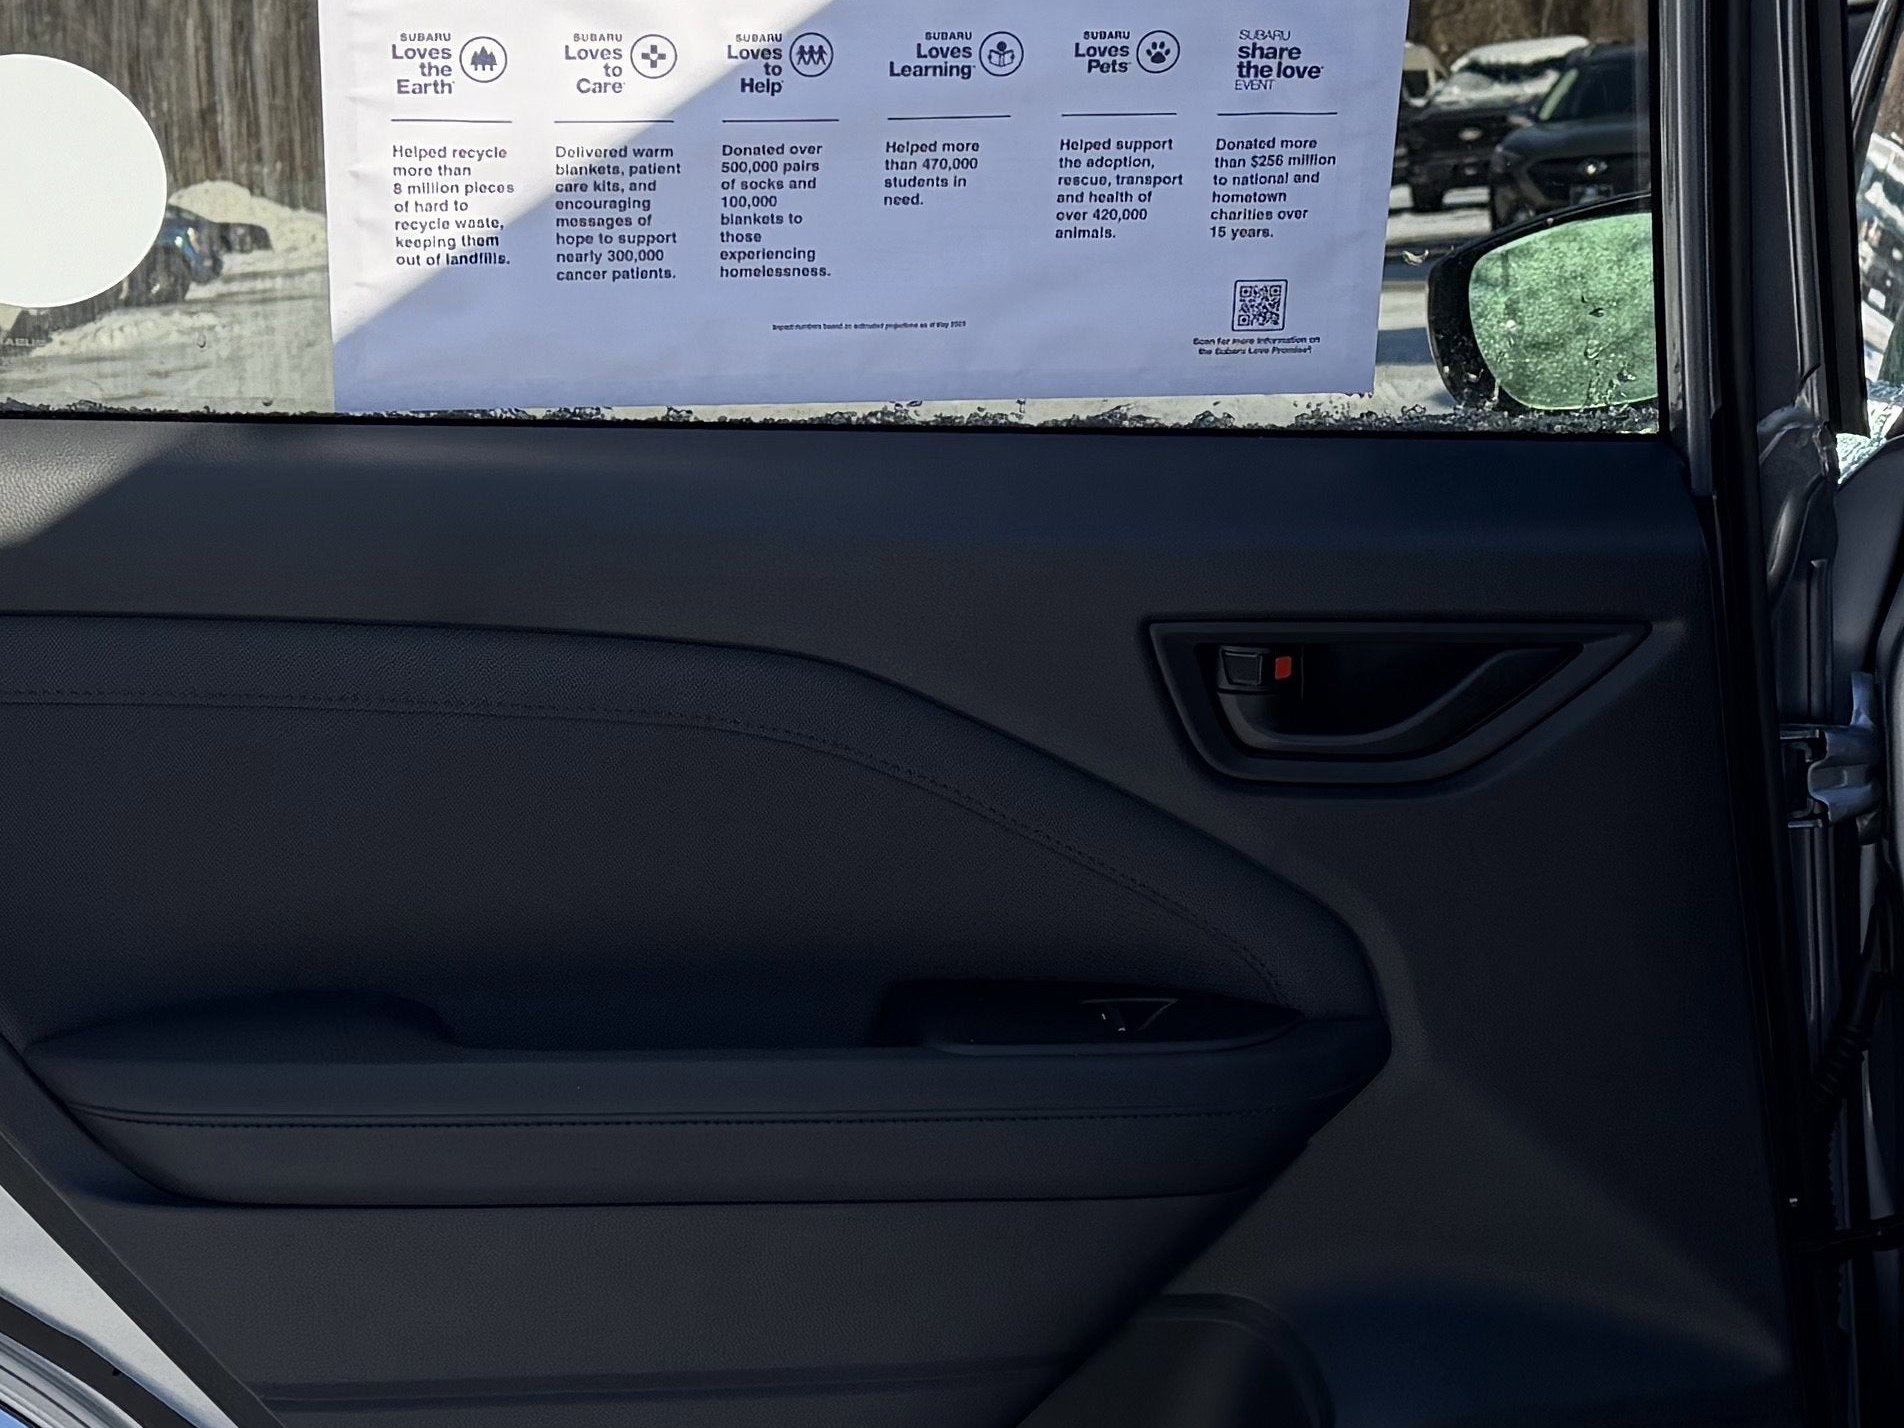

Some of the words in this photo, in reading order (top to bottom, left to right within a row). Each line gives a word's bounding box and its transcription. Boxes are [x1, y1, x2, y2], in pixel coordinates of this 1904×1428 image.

[400, 33, 451, 41] SUBARU
[574, 33, 622, 42] SUBARU
[736, 33, 782, 42] SUBARU
[925, 32, 972, 40] SUBARU
[1084, 31, 1130, 40] SUBARU
[1239, 30, 1290, 41] SUBARU
[392, 44, 452, 59] Loves
[565, 45, 622, 60] Loves
[728, 45, 782, 60] Loves
[917, 43, 972, 58] Loves
[1075, 43, 1129, 57] Loves
[1238, 42, 1301, 61] share
[419, 62, 452, 76] the
[603, 63, 622, 77] to
[764, 62, 782, 76] to
[890, 61, 971, 80] Learning
[1088, 59, 1128, 73] Pets
[1237, 60, 1273, 78] the
[1276, 61, 1321, 79] love
[397, 79, 455, 94] Earth
[576, 78, 622, 93] Care
[741, 78, 782, 96] Help
[1235, 79, 1275, 90] EVENT
[723, 143, 784, 156] Donated
[790, 146, 822, 154] over
[886, 141, 937, 156] Helped
[942, 143, 979, 152] more
[1060, 138, 1111, 153] Helped
[1116, 139, 1172, 153] support
[1216, 137, 1276, 150] Donated
[1281, 140, 1317, 148] more
[393, 145, 446, 161] Helped
[453, 147, 507, 161] recycle
[556, 145, 627, 158] Delivered
[633, 148, 673, 157] warm
[722, 161, 778, 174] 500,000
[783, 160, 819, 175] pairs
[885, 159, 917, 170] than
[922, 158, 978, 171] 470,000
[1059, 157, 1081, 168] the
[1087, 156, 1154, 170] adoption,
[1215, 157, 1246, 168] than
[1251, 154, 1283, 168] $256
[1288, 154, 1336, 165] million
[393, 167, 432, 176] more
[438, 165, 471, 176] than
[556, 164, 624, 176] blankets,
[629, 163, 680, 177] patient
[721, 178, 735, 190] of
[741, 178, 784, 190] socks
[789, 177, 816, 189] and
[885, 176, 948, 188] students
[954, 175, 966, 187] in
[1058, 176, 1111, 187] rescue,
[1116, 174, 1182, 188] transport
[1213, 175, 1227, 186] to
[1233, 172, 1288, 186] national
[1294, 172, 1319, 183] and
[394, 183, 402, 194] 8
[408, 182, 459, 194] million
[465, 182, 514, 196] pieces
[556, 183, 588, 193] care
[594, 180, 624, 193] kits,
[629, 180, 656, 191] and
[722, 196, 777, 209] 100,000
[884, 193, 923, 205] need.
[1057, 191, 1084, 203] and
[1089, 191, 1133, 203] health
[1138, 191, 1152, 202] of
[1212, 191, 1286, 203] hometown
[394, 201, 408, 212] of
[415, 200, 448, 212] hard
[454, 200, 468, 211] to
[555, 197, 650, 212] encouraging
[721, 213, 783, 225] blankets
[789, 213, 802, 224] to
[1056, 212, 1088, 221] over
[1093, 208, 1147, 222] 420,000
[1211, 208, 1273, 220] charities
[1278, 210, 1308, 220] over
[395, 218, 449, 233] recycle
[455, 218, 503, 230] waste,
[556, 217, 632, 230] messages
[638, 214, 652, 226] of
[720, 231, 761, 242] those
[1056, 226, 1115, 238] animals.
[1210, 226, 1226, 238] 15
[1231, 228, 1273, 240] years.
[396, 236, 456, 251] keeping
[462, 235, 499, 247] them
[556, 233, 593, 248] hope
[599, 233, 613, 244] to
[618, 232, 676, 246] support
[396, 255, 420, 266] out
[426, 253, 440, 265] of
[446, 252, 509, 265] landfills.
[557, 250, 602, 265] nearly
[608, 249, 664, 263] 300,000
[720, 247, 815, 263] experiencing
[557, 270, 607, 281] cancer
[612, 267, 675, 282] patients.
[720, 265, 831, 277] homelessness.
